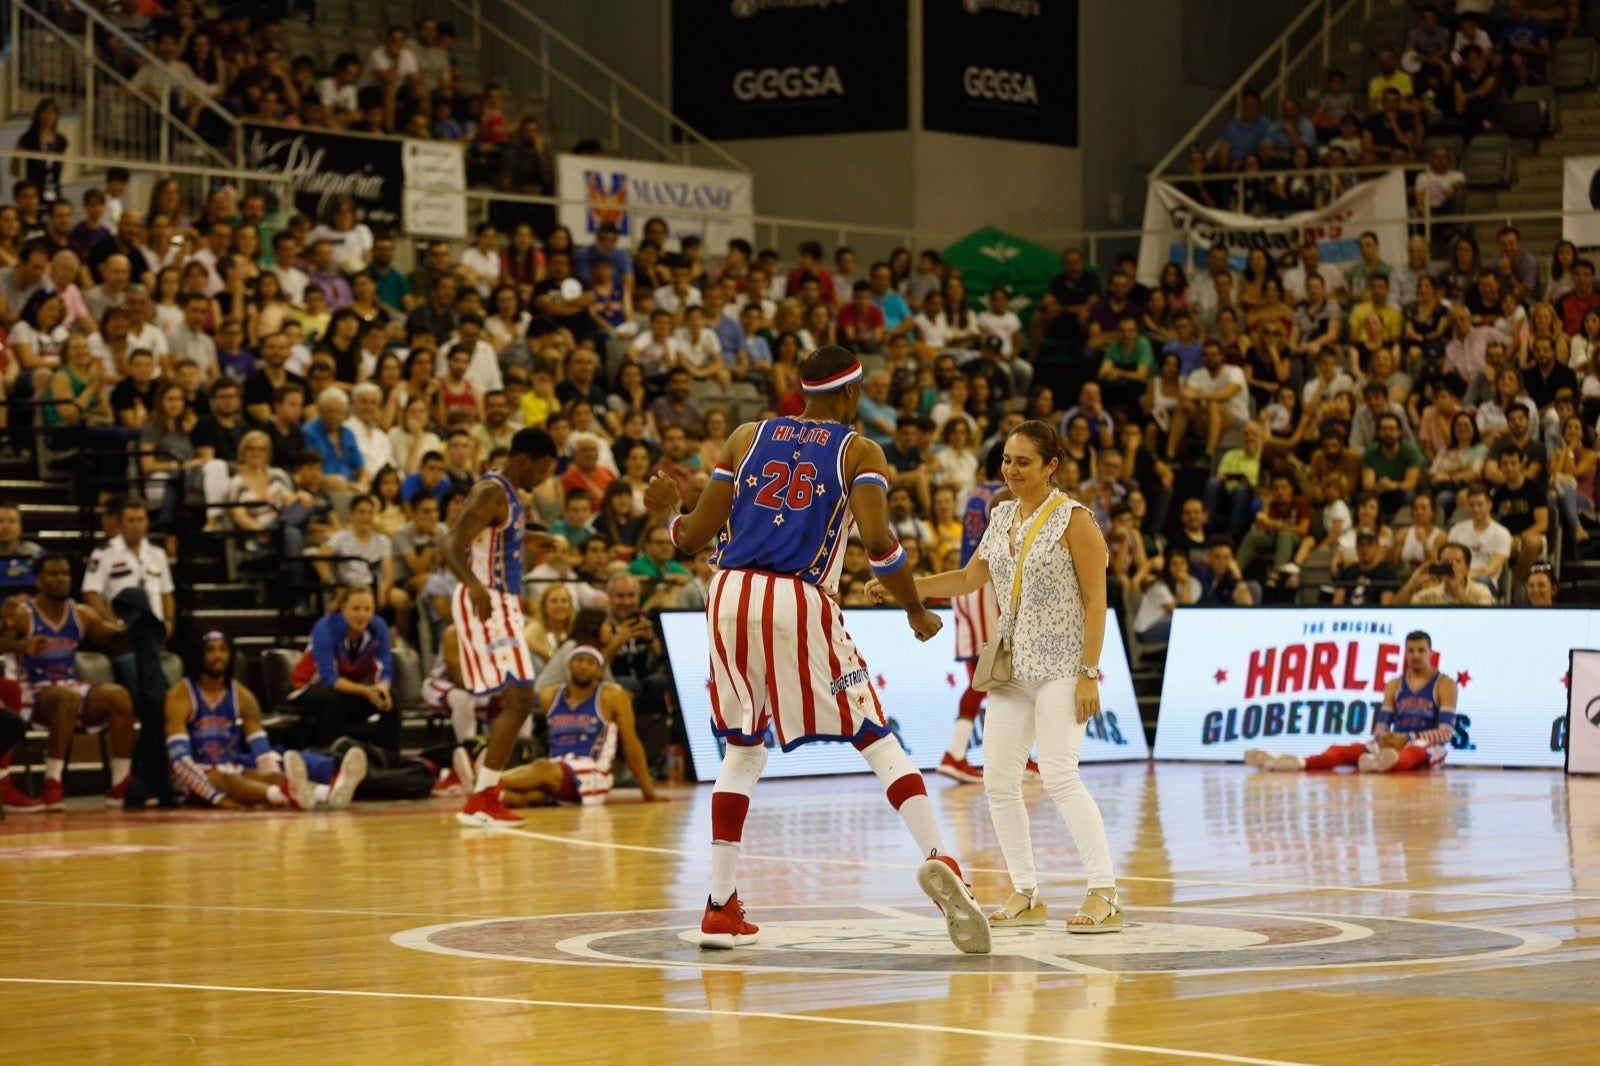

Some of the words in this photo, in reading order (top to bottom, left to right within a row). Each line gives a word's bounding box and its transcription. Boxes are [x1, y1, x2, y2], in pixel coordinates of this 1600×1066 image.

[632, 178, 732, 210] MANZANO
[772, 425, 831, 446] HI-LITE
[754, 460, 818, 511] 26
[1303, 622, 1325, 635] THE
[1332, 621, 1394, 636] ORIGINAL
